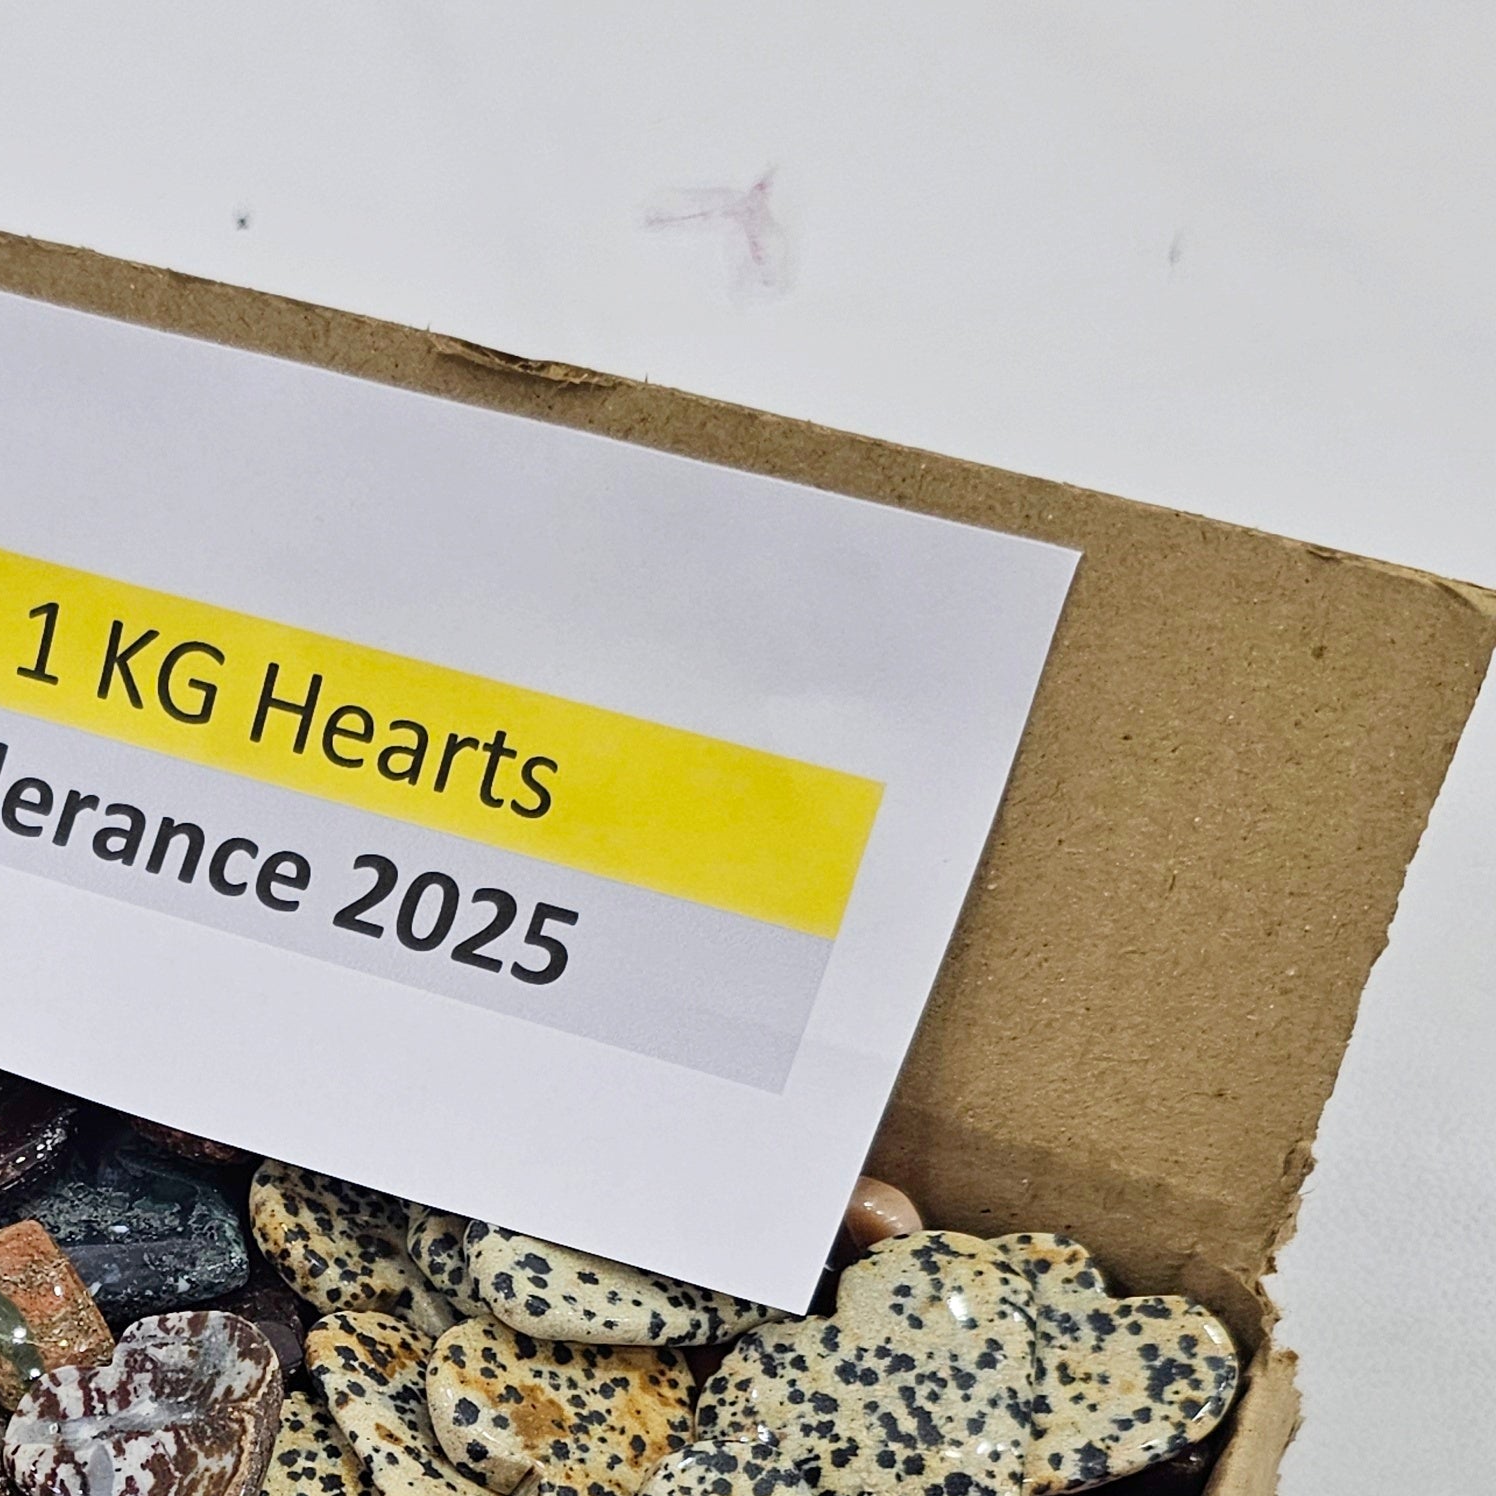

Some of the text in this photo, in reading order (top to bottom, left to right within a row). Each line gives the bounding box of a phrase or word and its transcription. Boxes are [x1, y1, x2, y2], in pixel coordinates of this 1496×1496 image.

[17, 603, 557, 818] 1 KG Hearts
[333, 854, 578, 985] 2025
